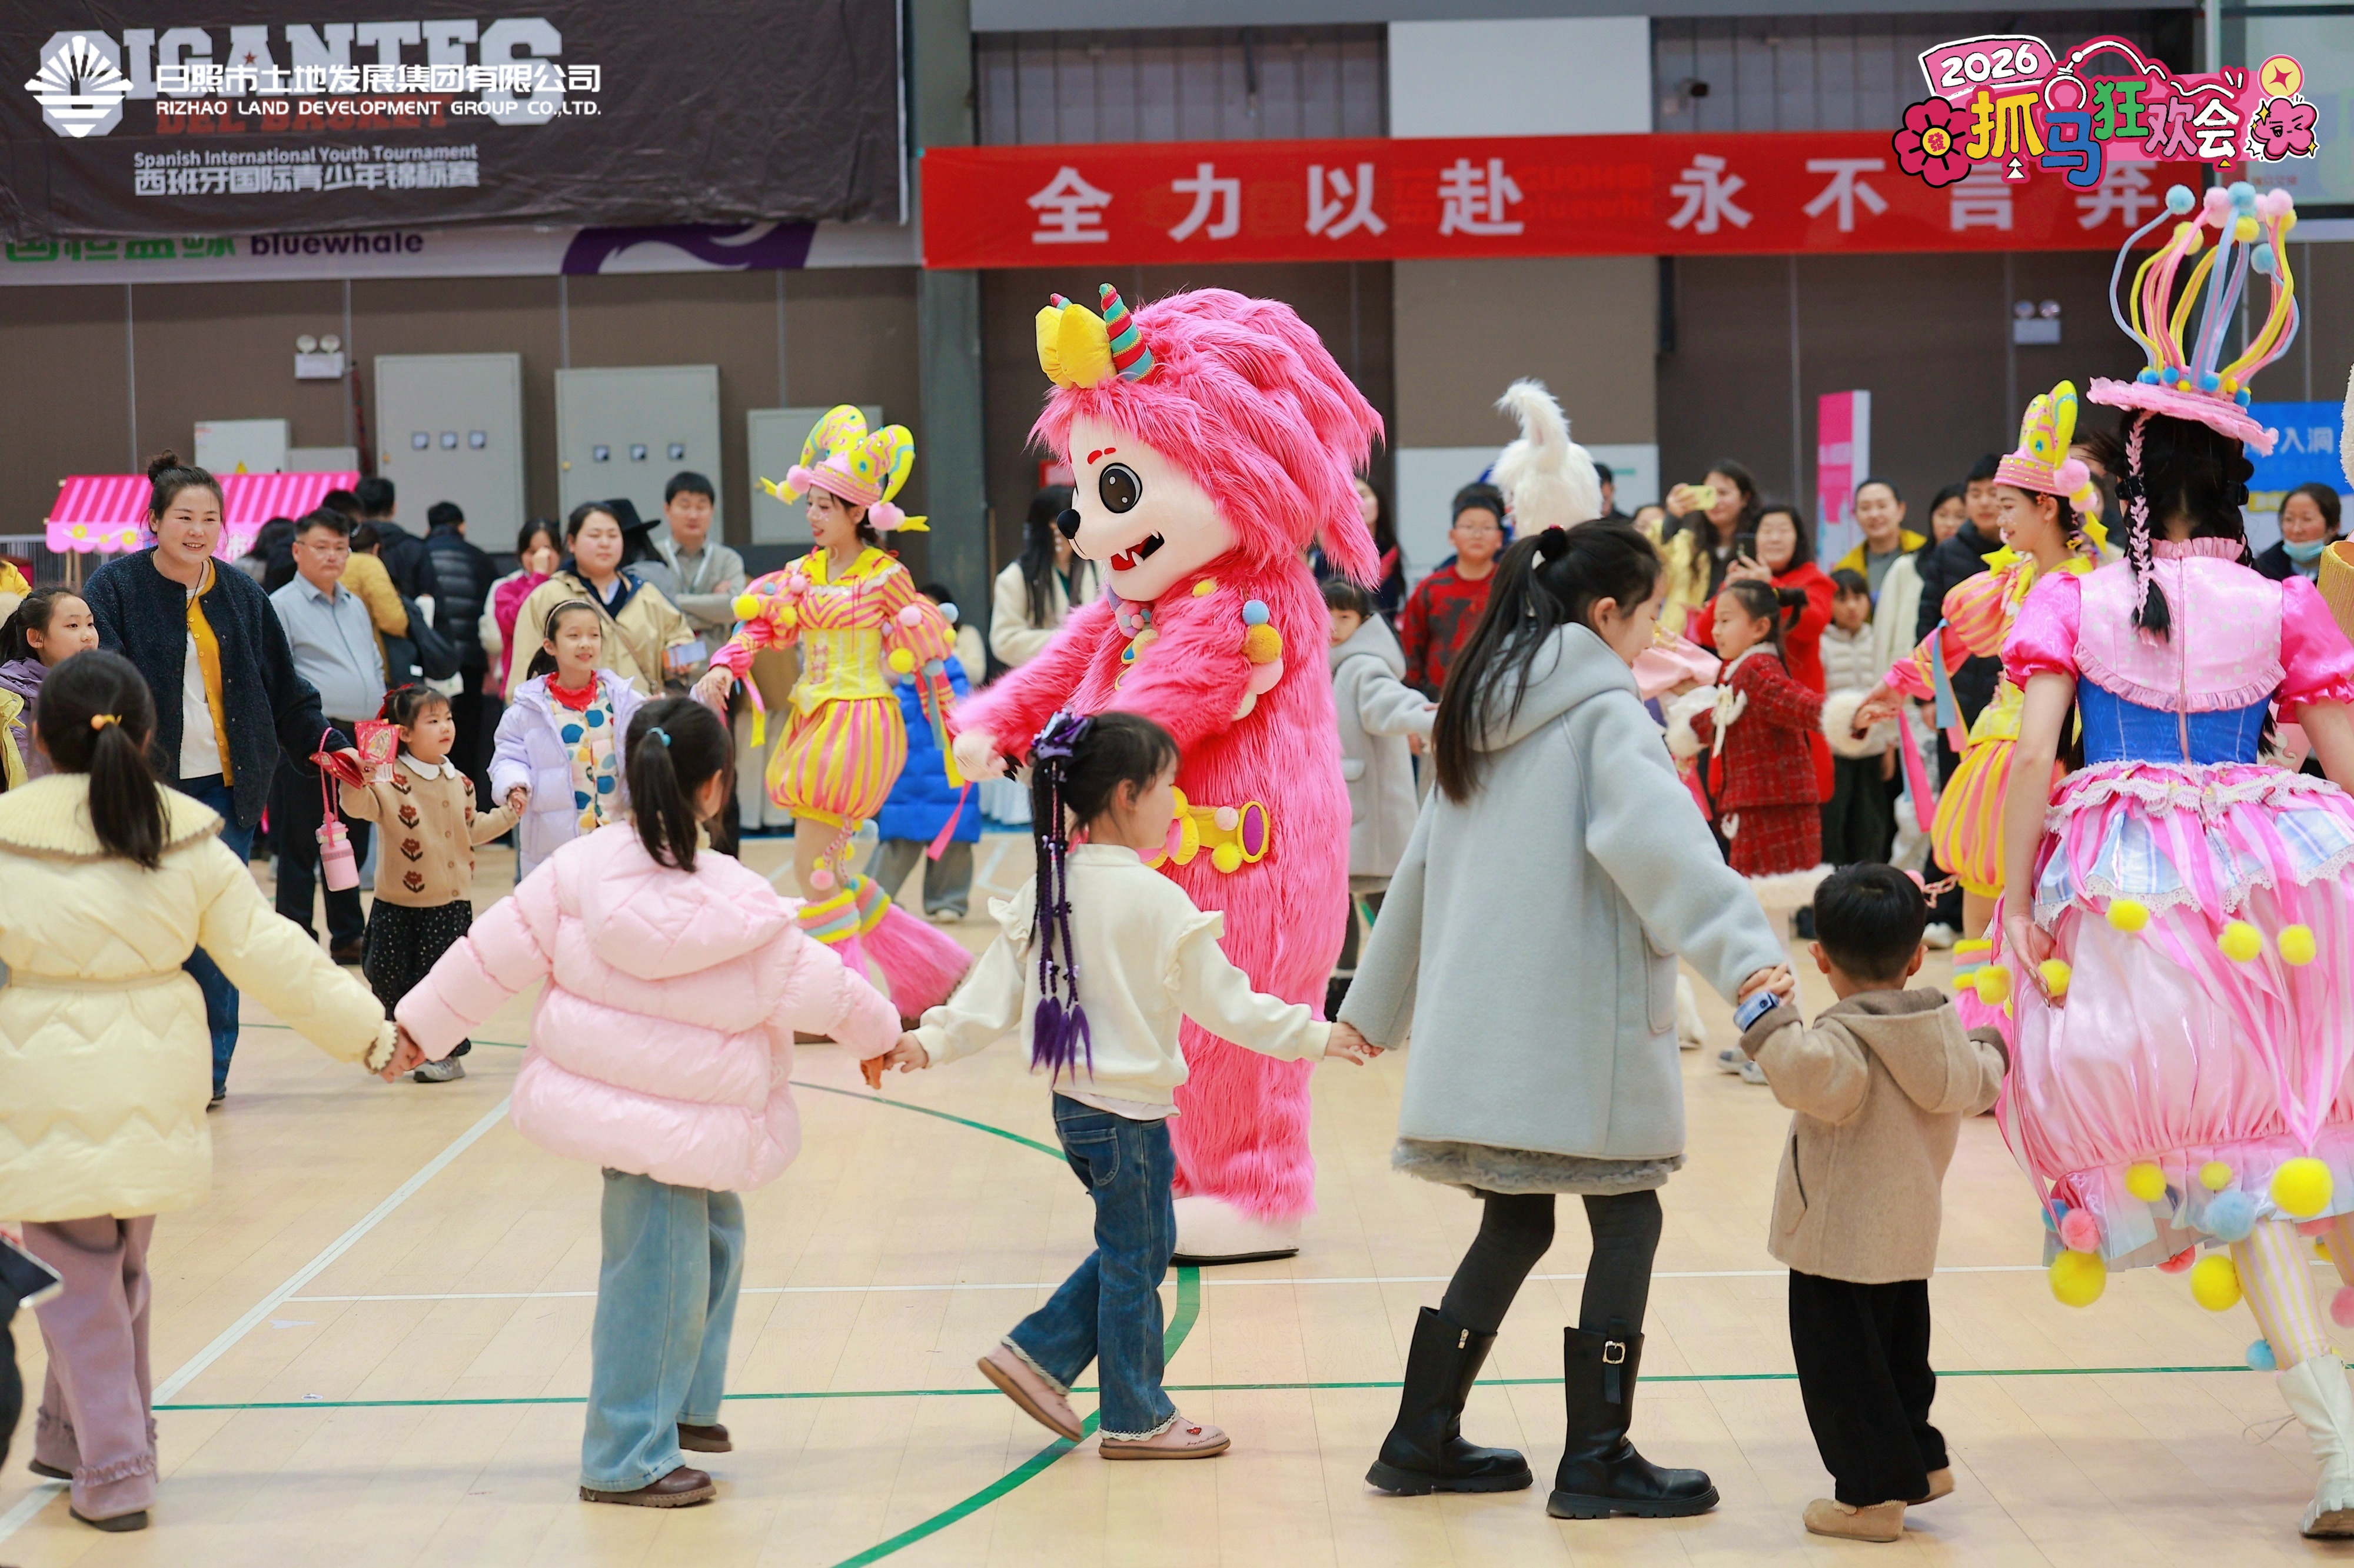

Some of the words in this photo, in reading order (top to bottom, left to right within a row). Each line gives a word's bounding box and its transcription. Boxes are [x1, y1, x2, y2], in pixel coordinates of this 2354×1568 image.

[134, 149, 201, 168] Spanish
[204, 146, 317, 166] International
[318, 144, 370, 162] Youth
[372, 143, 478, 161] Tournament
[1026, 157, 1524, 244] 全力以赴
[251, 232, 423, 255] bluewhale
